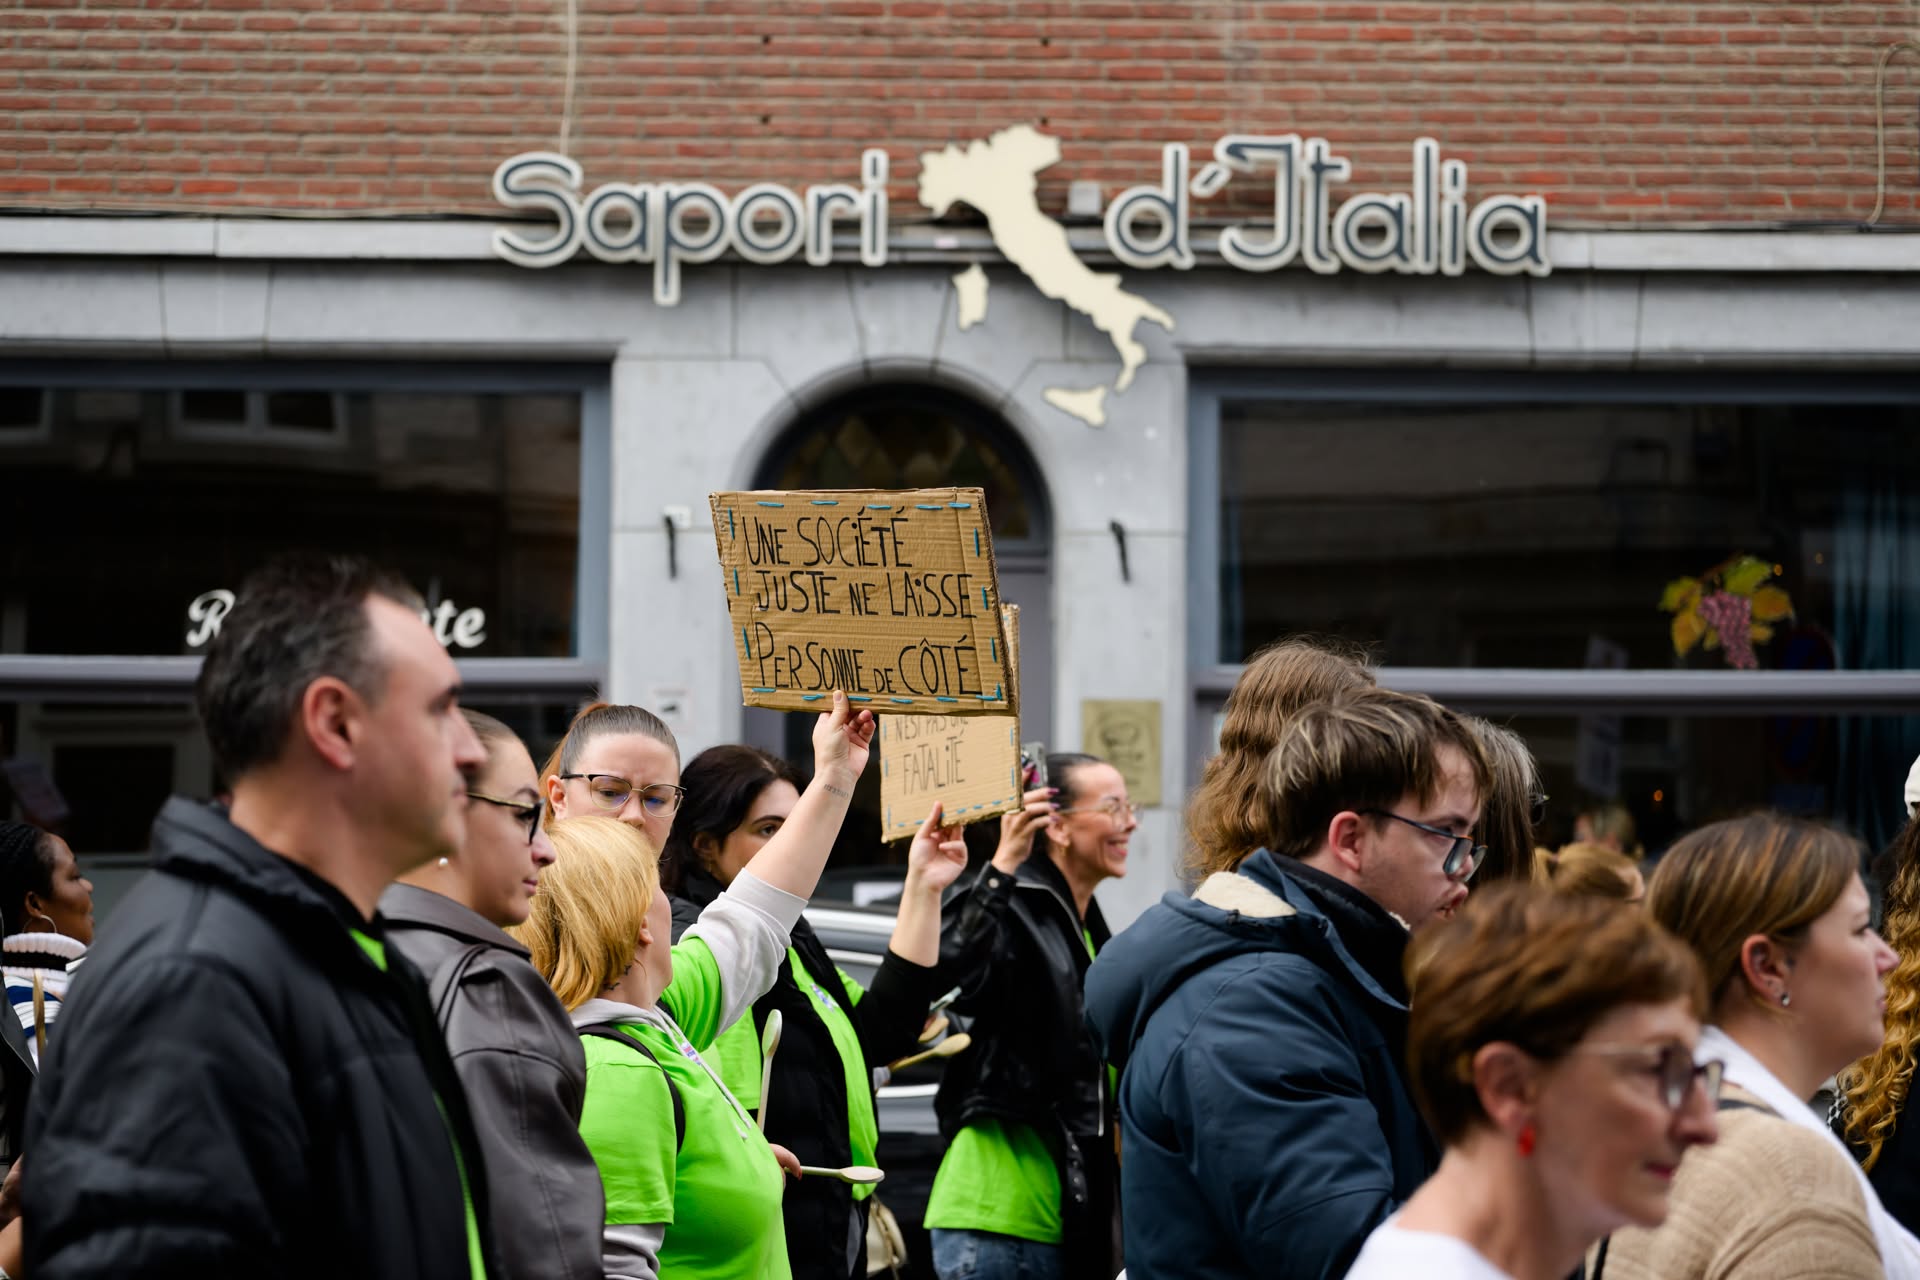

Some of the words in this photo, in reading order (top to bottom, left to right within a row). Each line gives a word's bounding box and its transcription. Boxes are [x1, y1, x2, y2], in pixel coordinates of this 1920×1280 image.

[492, 149, 890, 307] Sapori
[1104, 134, 1551, 277] d'Italia
[742, 516, 791, 566] UNE
[755, 570, 841, 615] JUSTE
[849, 583, 879, 617] NE
[755, 621, 870, 693] PERSONNE
[873, 667, 897, 694] DE
[898, 634, 983, 695] CÔTÉ
